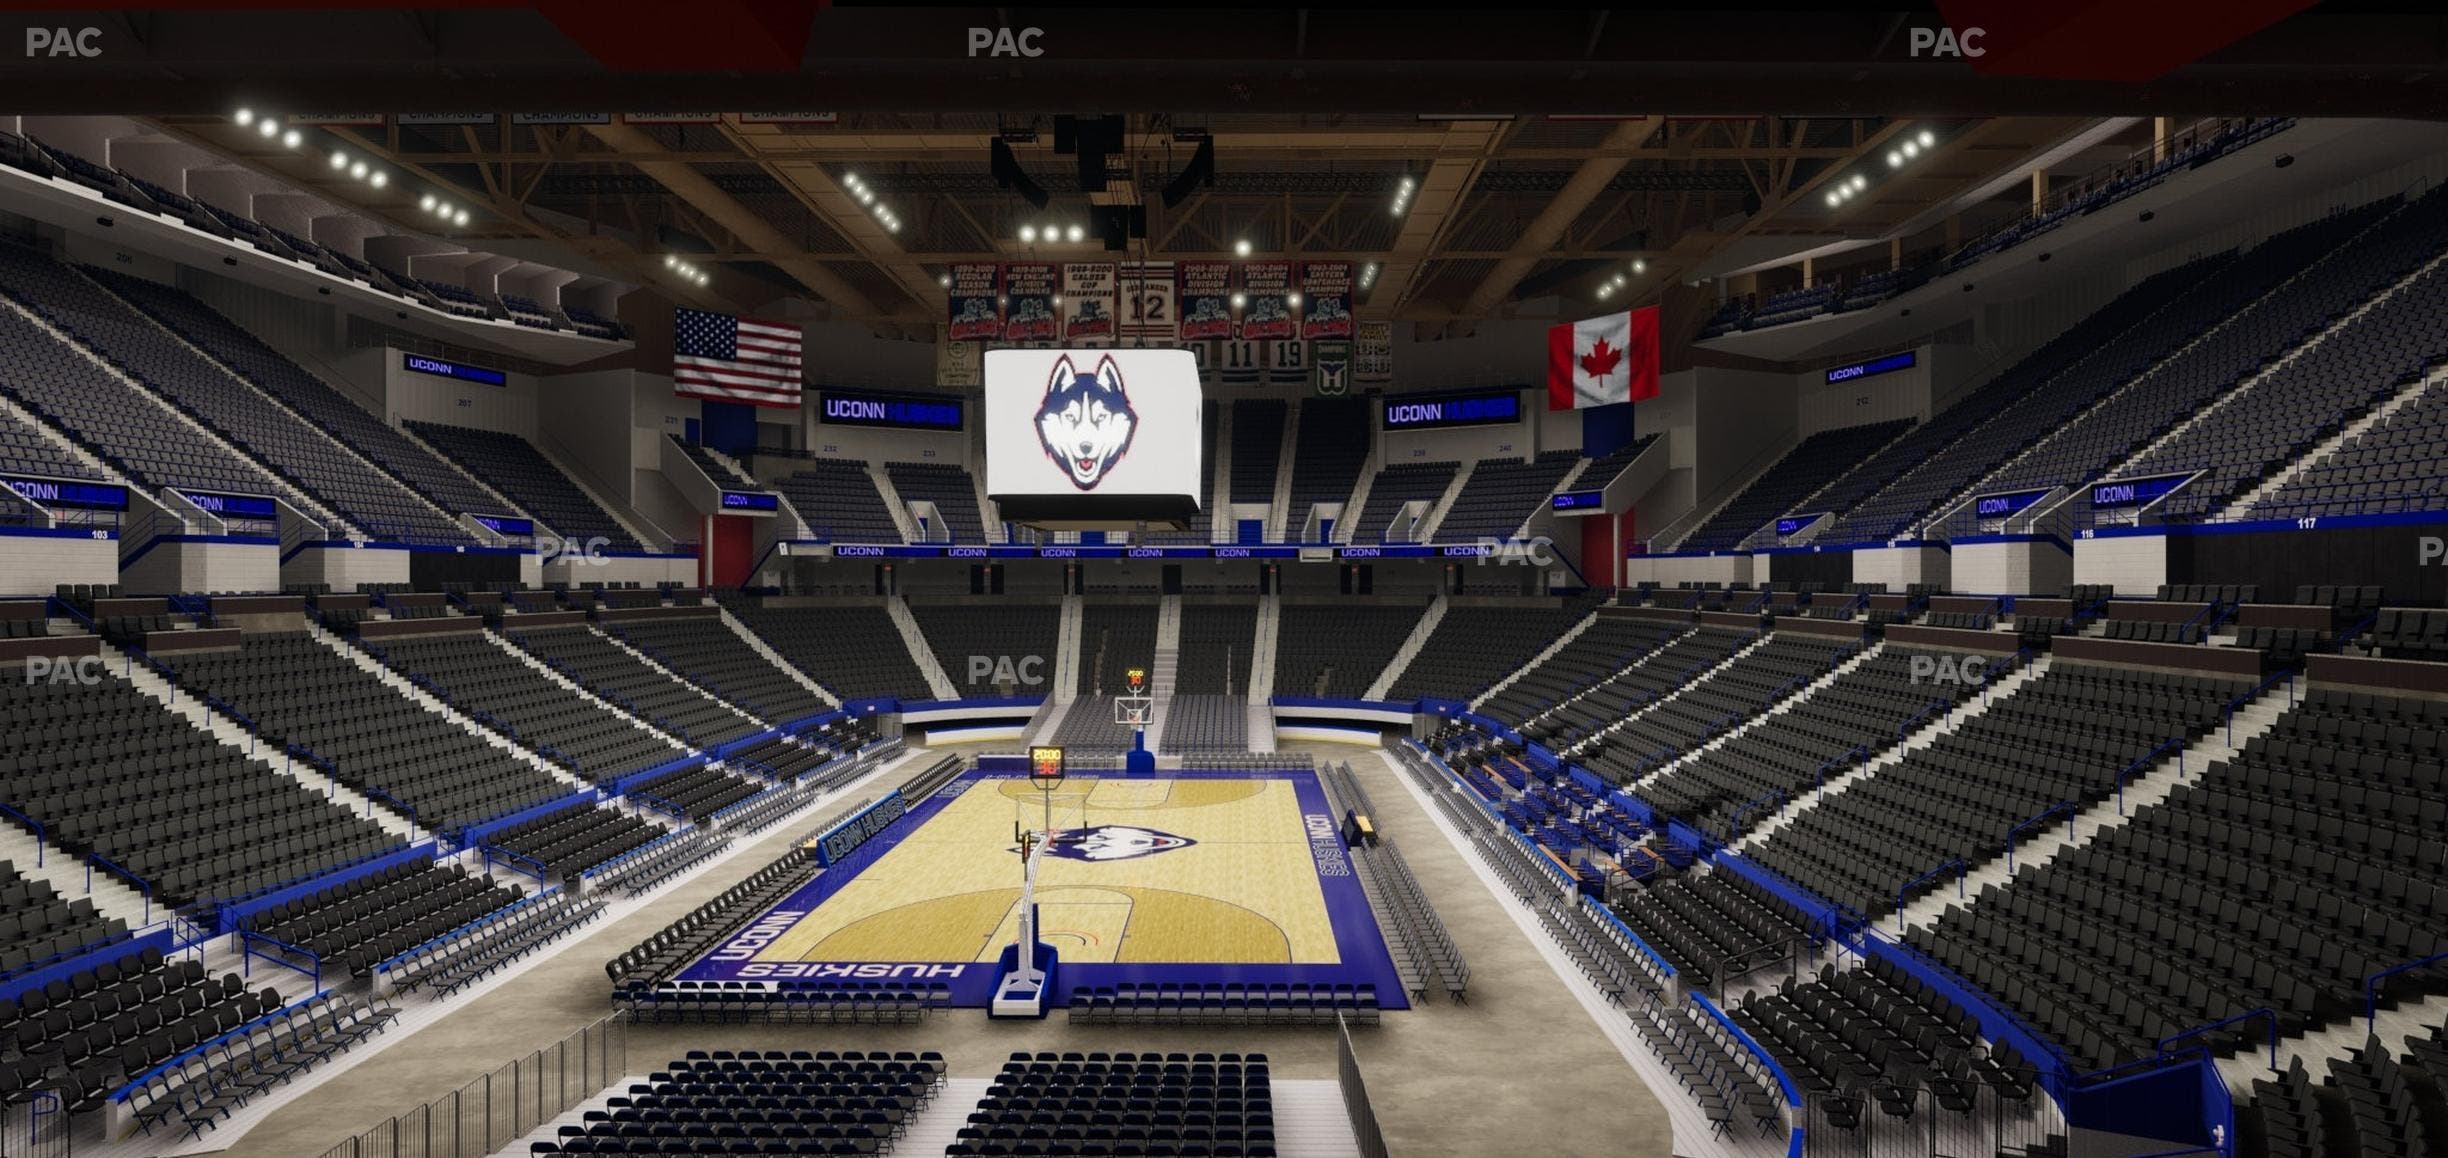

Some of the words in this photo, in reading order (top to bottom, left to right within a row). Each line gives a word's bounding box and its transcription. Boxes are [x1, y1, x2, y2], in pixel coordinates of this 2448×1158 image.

[1185, 272, 1228, 280] ATLANTIC
[1246, 272, 1288, 280] ATLANTIC
[1187, 280, 1226, 288] DIVISION
[1248, 280, 1286, 288] DIVISION
[951, 288, 998, 297] CHAMPIONS
[1065, 290, 1114, 298] CHAMPIONS
[1183, 288, 1231, 297] CHAMPIONS
[1242, 288, 1291, 297] CHAMPIONS
[1131, 296, 1166, 320] 12
[1229, 342, 1253, 368] 11
[1277, 342, 1302, 368] 19
[409, 357, 452, 375] UCONN
[1829, 365, 1864, 381] UCONN
[826, 399, 885, 419] UCONN
[1388, 402, 1442, 423] UCONN
[2094, 485, 2135, 504] UCONN
[187, 495, 223, 511] CONN
[1978, 498, 2009, 515] UCONN
[2297, 517, 2317, 529] 117
[91, 530, 109, 540] 103
[837, 547, 885, 558] UCONN
[948, 549, 988, 559] UCONN
[1041, 550, 1077, 559] UCONN
[1127, 550, 1163, 558] UCONN
[1214, 550, 1250, 558] UCONN
[1340, 549, 1381, 558] UCONN
[1443, 546, 1490, 557] UCONN
[1033, 750, 1062, 760] 20:00
[1039, 761, 1057, 774] 30
[1304, 814, 1336, 841] UCONN
[822, 819, 867, 864] UCONN
[1311, 838, 1351, 877] HUSKIES
[710, 910, 806, 961] UCONN
[736, 963, 966, 978] HUSKIES
